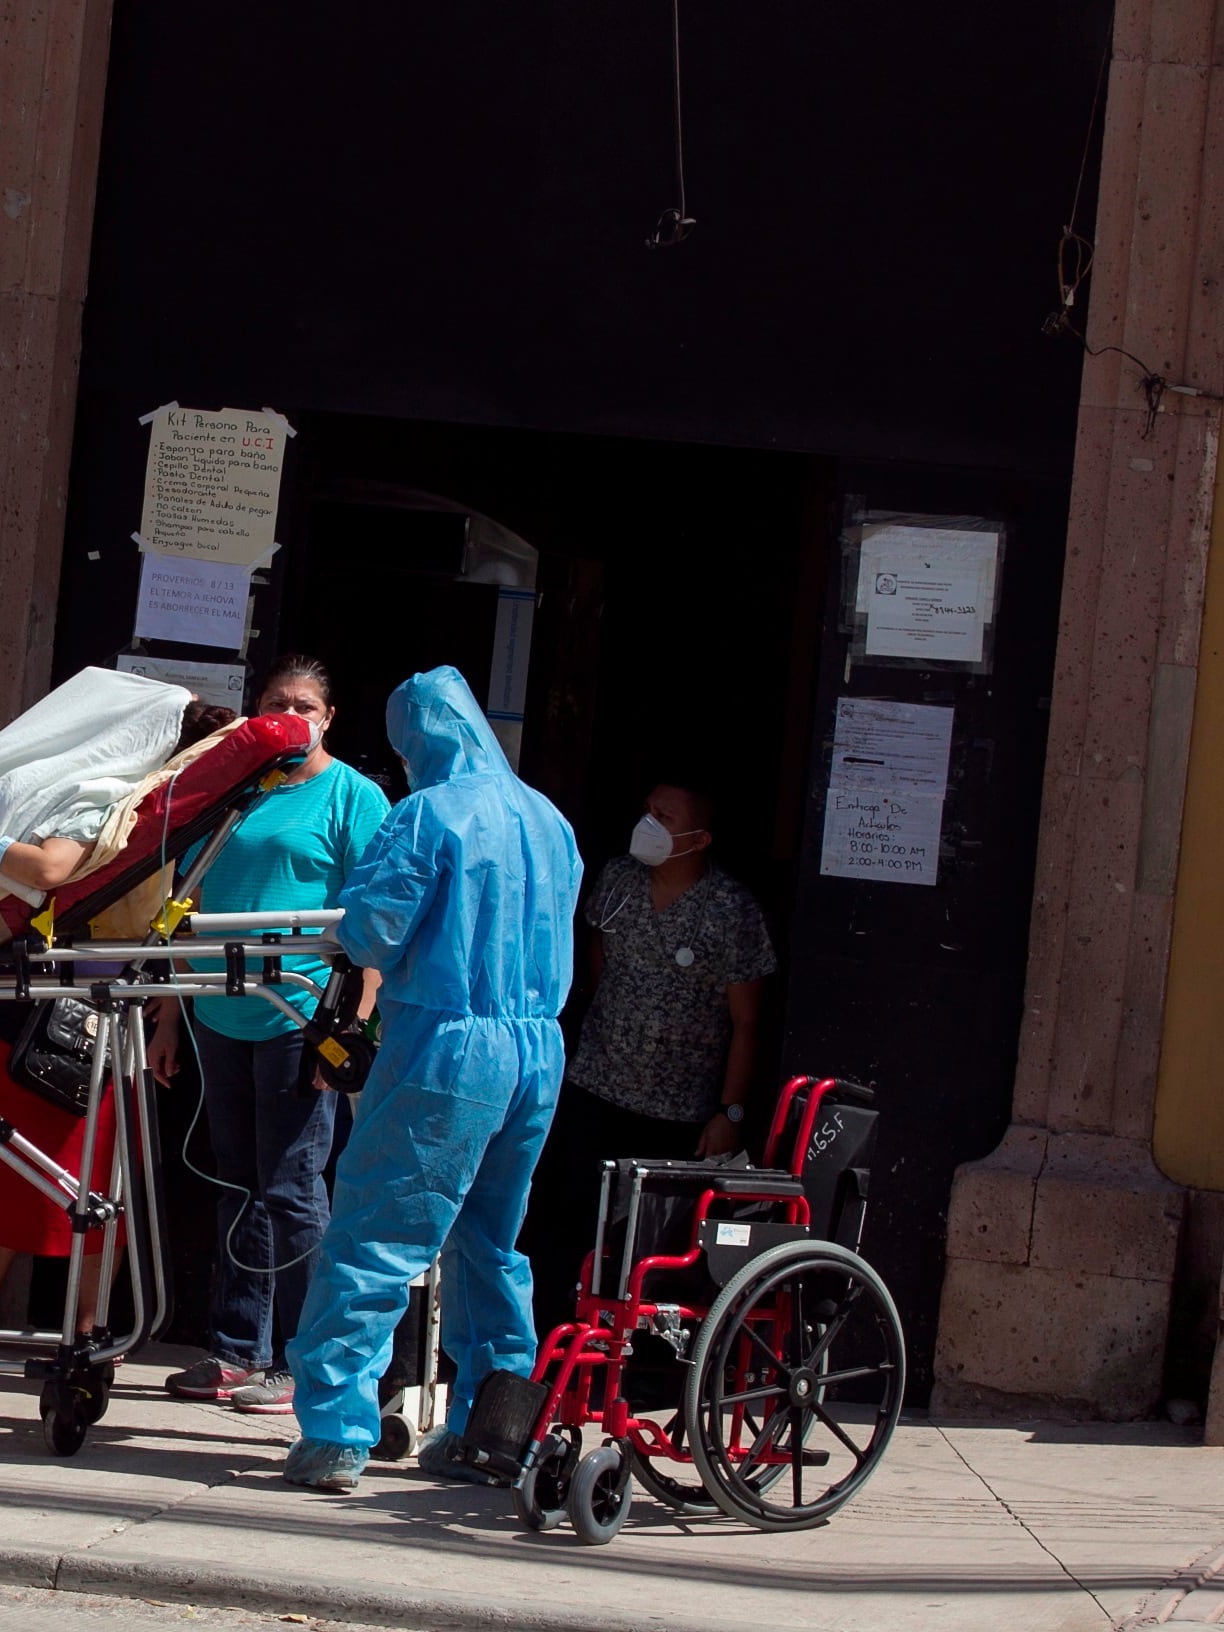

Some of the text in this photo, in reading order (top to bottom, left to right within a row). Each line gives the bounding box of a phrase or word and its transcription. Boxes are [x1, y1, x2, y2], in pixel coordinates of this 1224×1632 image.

[167, 411, 186, 426] Kit
[246, 421, 271, 434] Para
[172, 430, 216, 442] Paciente
[220, 436, 236, 444] en
[210, 448, 236, 459] para
[240, 449, 266, 461] baño
[157, 460, 226, 475] Cepillo Dental
[228, 460, 250, 470] para
[157, 478, 188, 487] Crema
[189, 472, 224, 482] Dental
[157, 486, 216, 498] Desodorante
[156, 502, 170, 510] no
[196, 498, 206, 506] de
[236, 504, 246, 512] de
[248, 506, 272, 518] pegar
[197, 541, 220, 550] bucal
[152, 573, 204, 586] PROVERBIOS
[150, 588, 160, 596] EL
[162, 589, 192, 600] TEMOR
[148, 600, 241, 620] ES ABORRECER EL MAL
[890, 804, 908, 814] De
[910, 847, 925, 856] AM
[904, 861, 922, 872] PM
